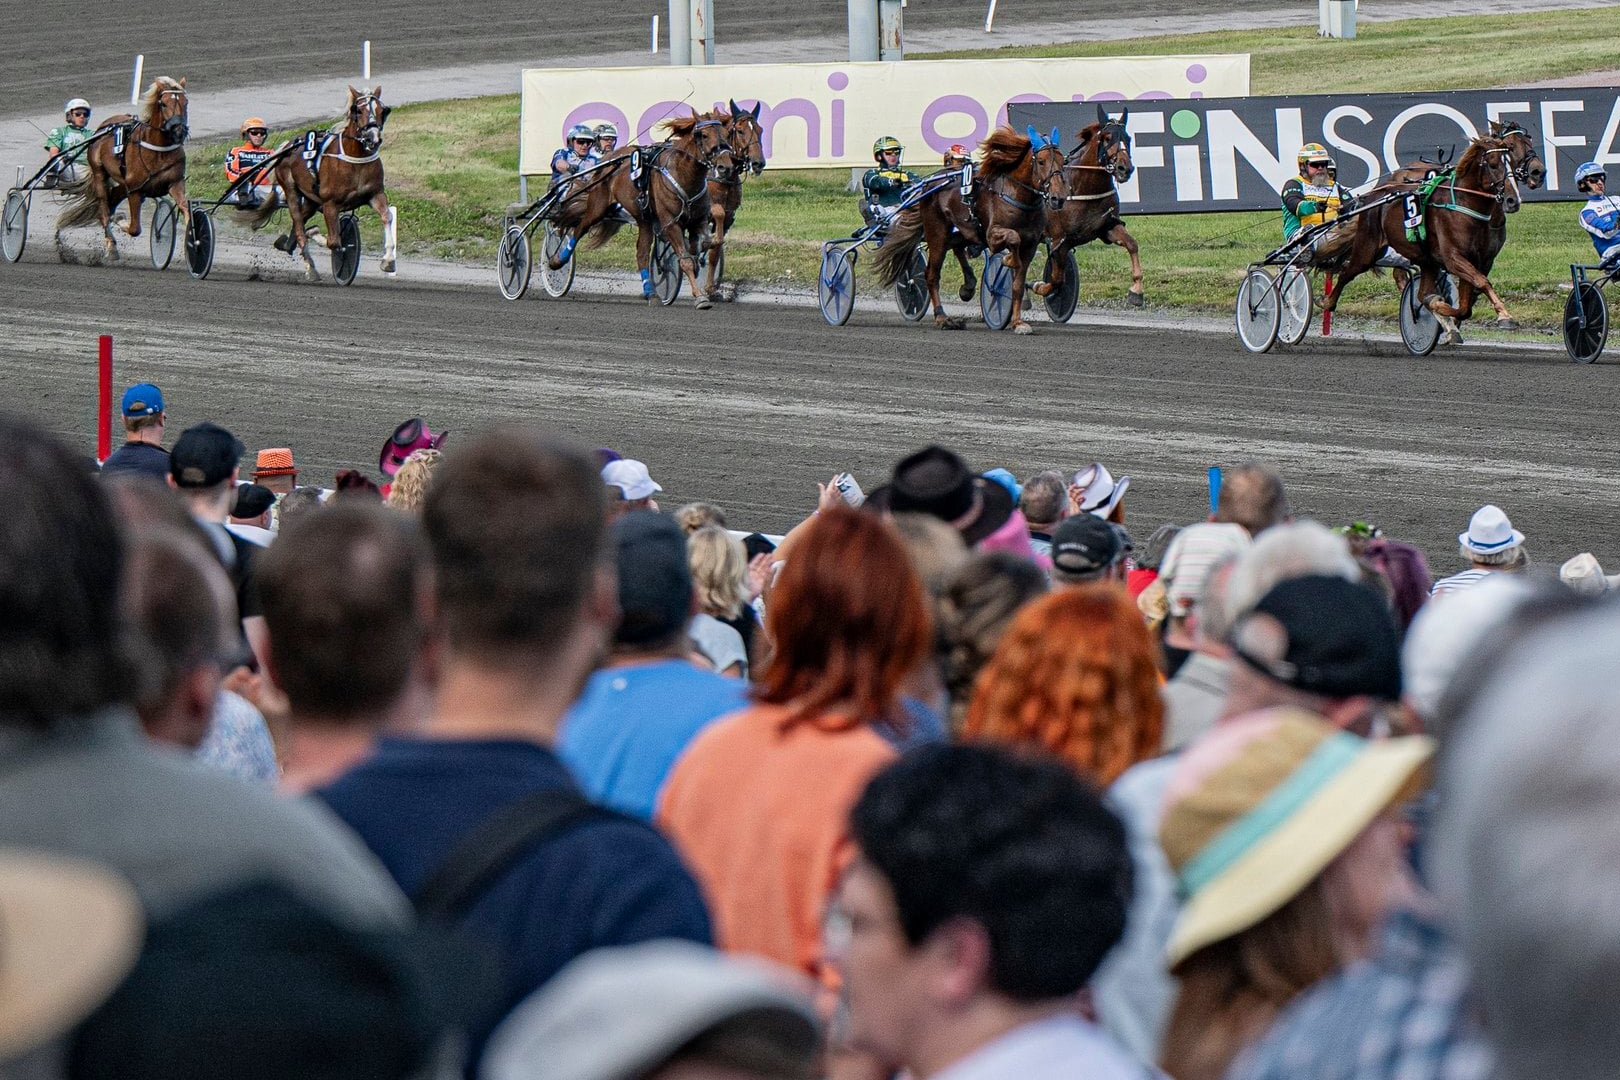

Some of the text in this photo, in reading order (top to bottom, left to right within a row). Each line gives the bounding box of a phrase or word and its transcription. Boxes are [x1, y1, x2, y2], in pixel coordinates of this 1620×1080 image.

[307, 131, 316, 151] 8
[632, 150, 640, 171] 9
[961, 164, 971, 185] 10
[1406, 194, 1418, 218] 5
